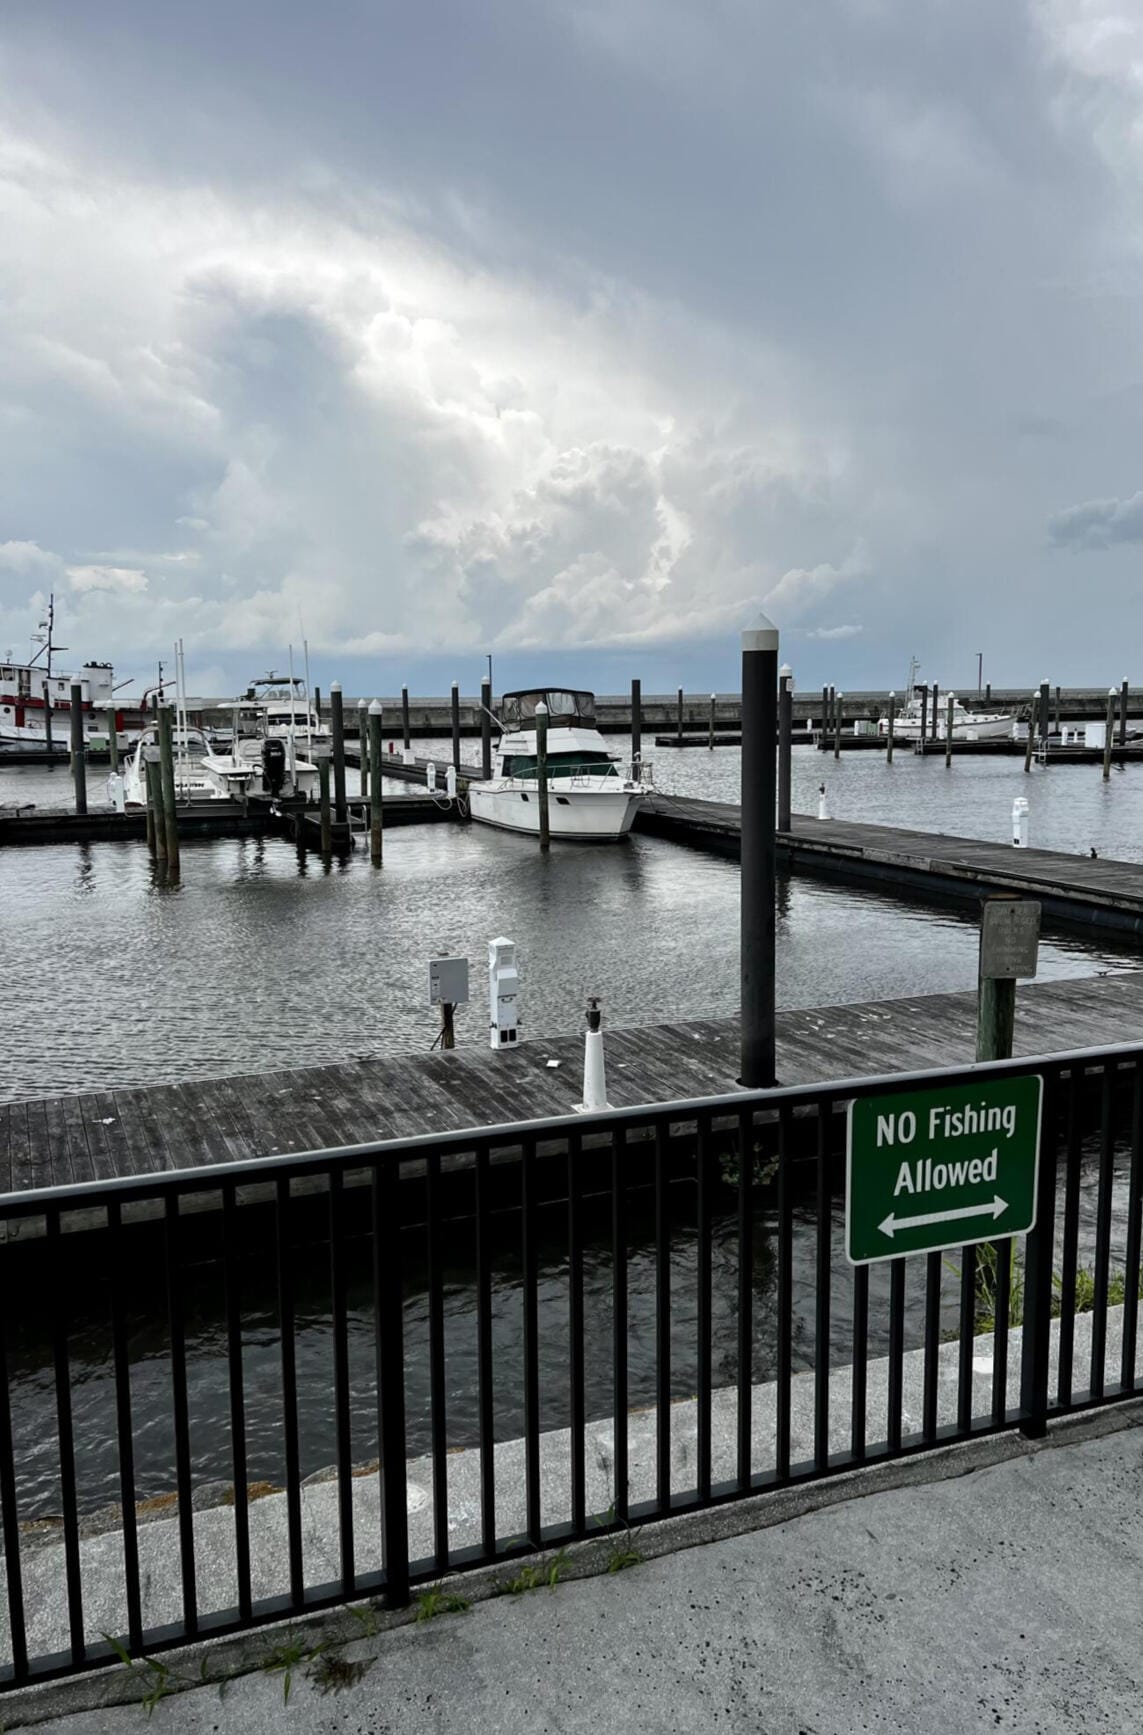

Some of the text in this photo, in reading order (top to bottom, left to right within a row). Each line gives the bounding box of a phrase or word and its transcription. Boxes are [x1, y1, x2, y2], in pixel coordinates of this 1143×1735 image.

[877, 1102, 1016, 1147] NO Fishing
[893, 1148, 998, 1196] Allowed
